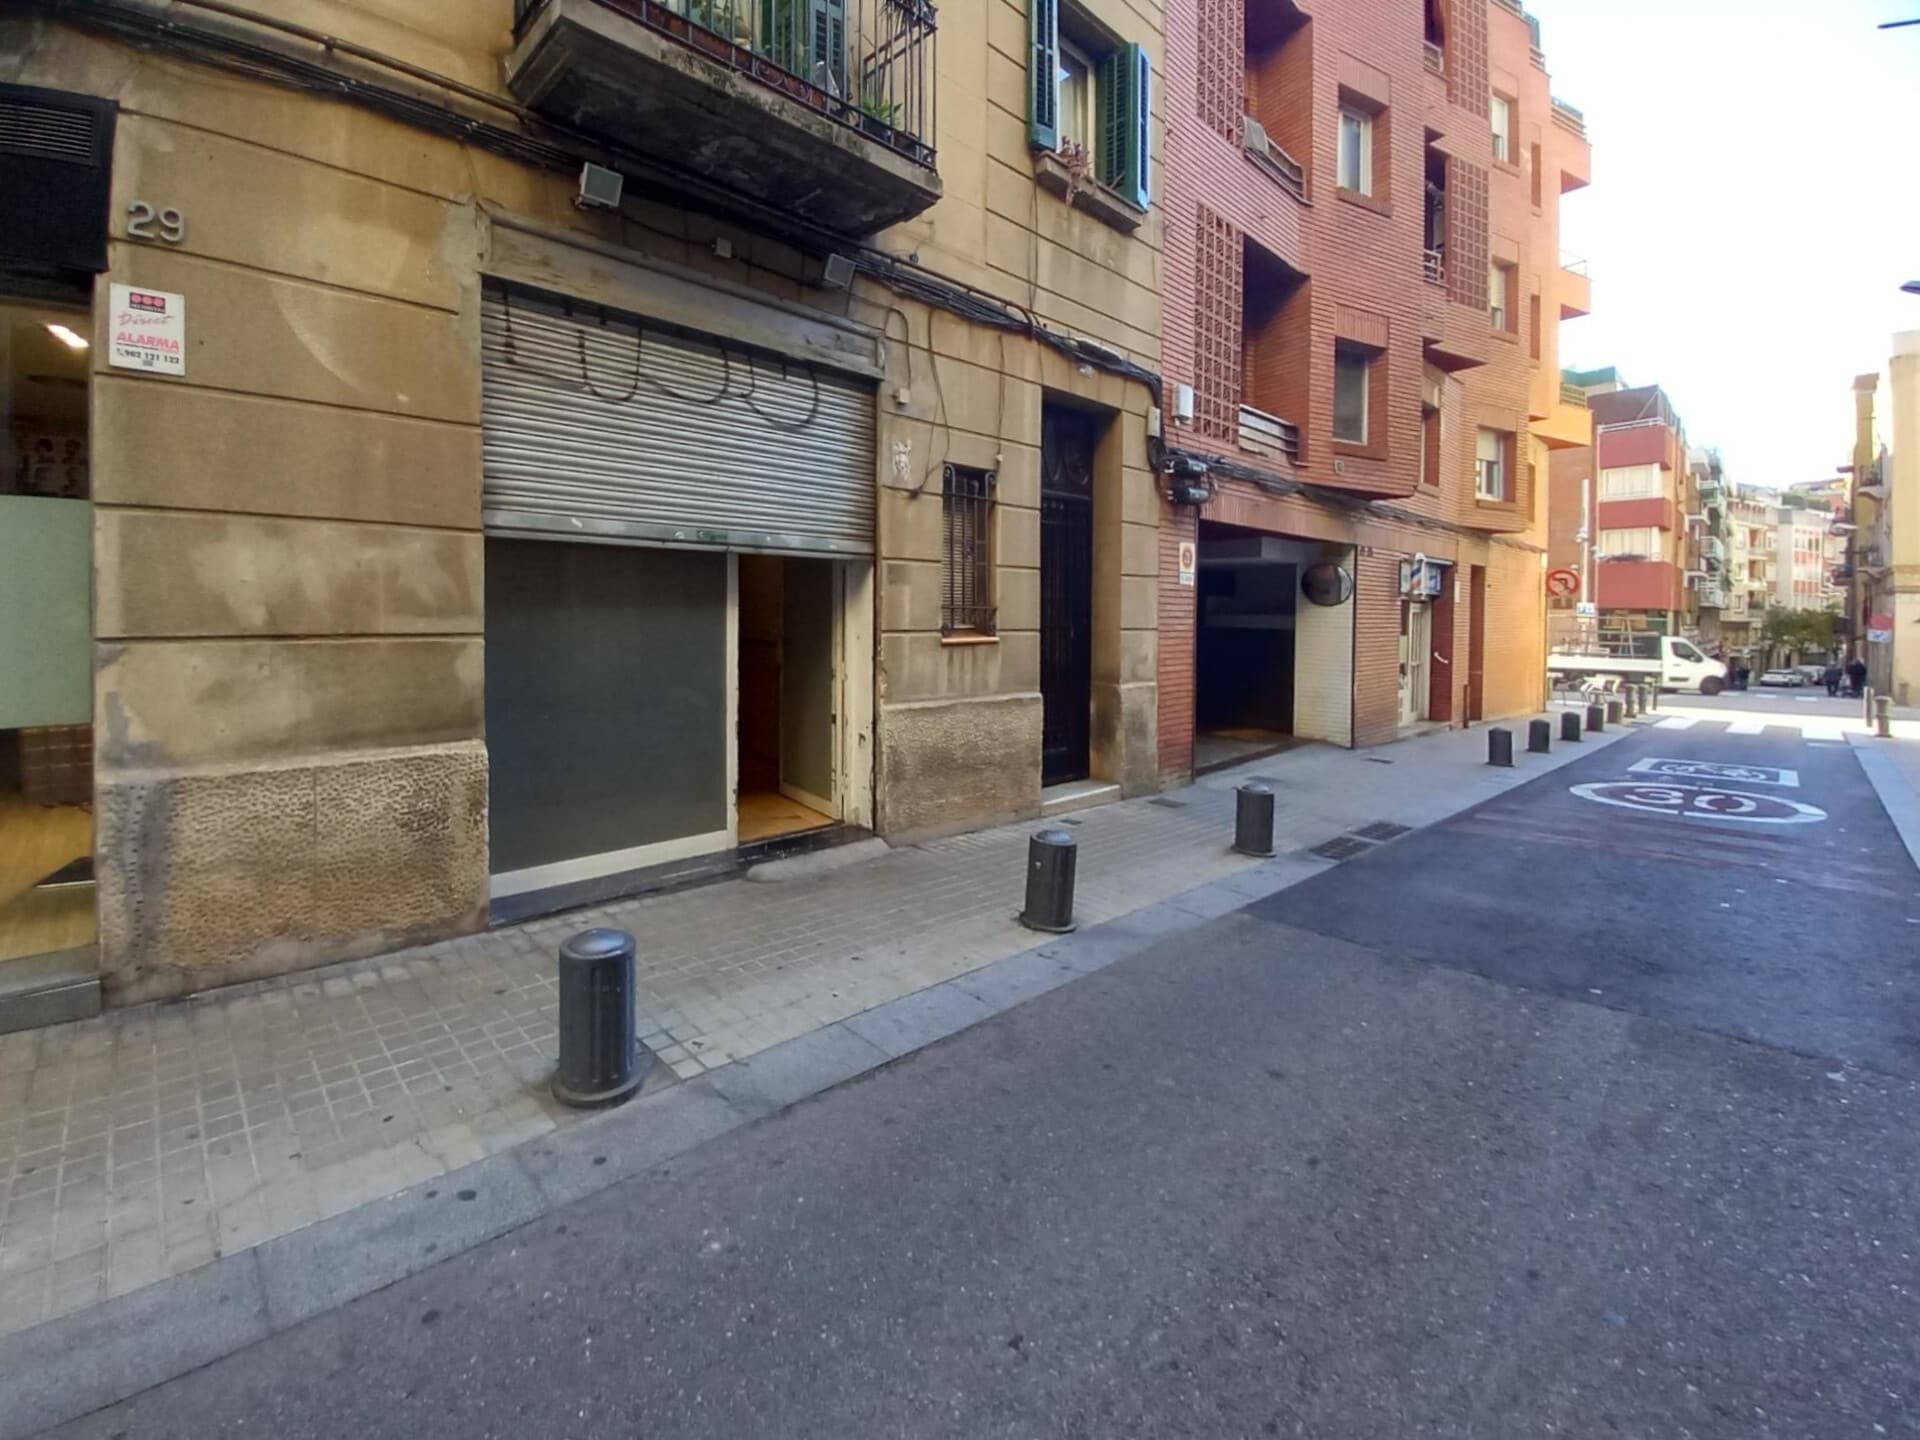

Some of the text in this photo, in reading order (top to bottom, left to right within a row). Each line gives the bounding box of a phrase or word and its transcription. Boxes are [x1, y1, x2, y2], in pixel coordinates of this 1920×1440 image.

[127, 200, 187, 243] 29
[116, 331, 180, 353] ALARMA
[1624, 787, 1757, 813] 30
